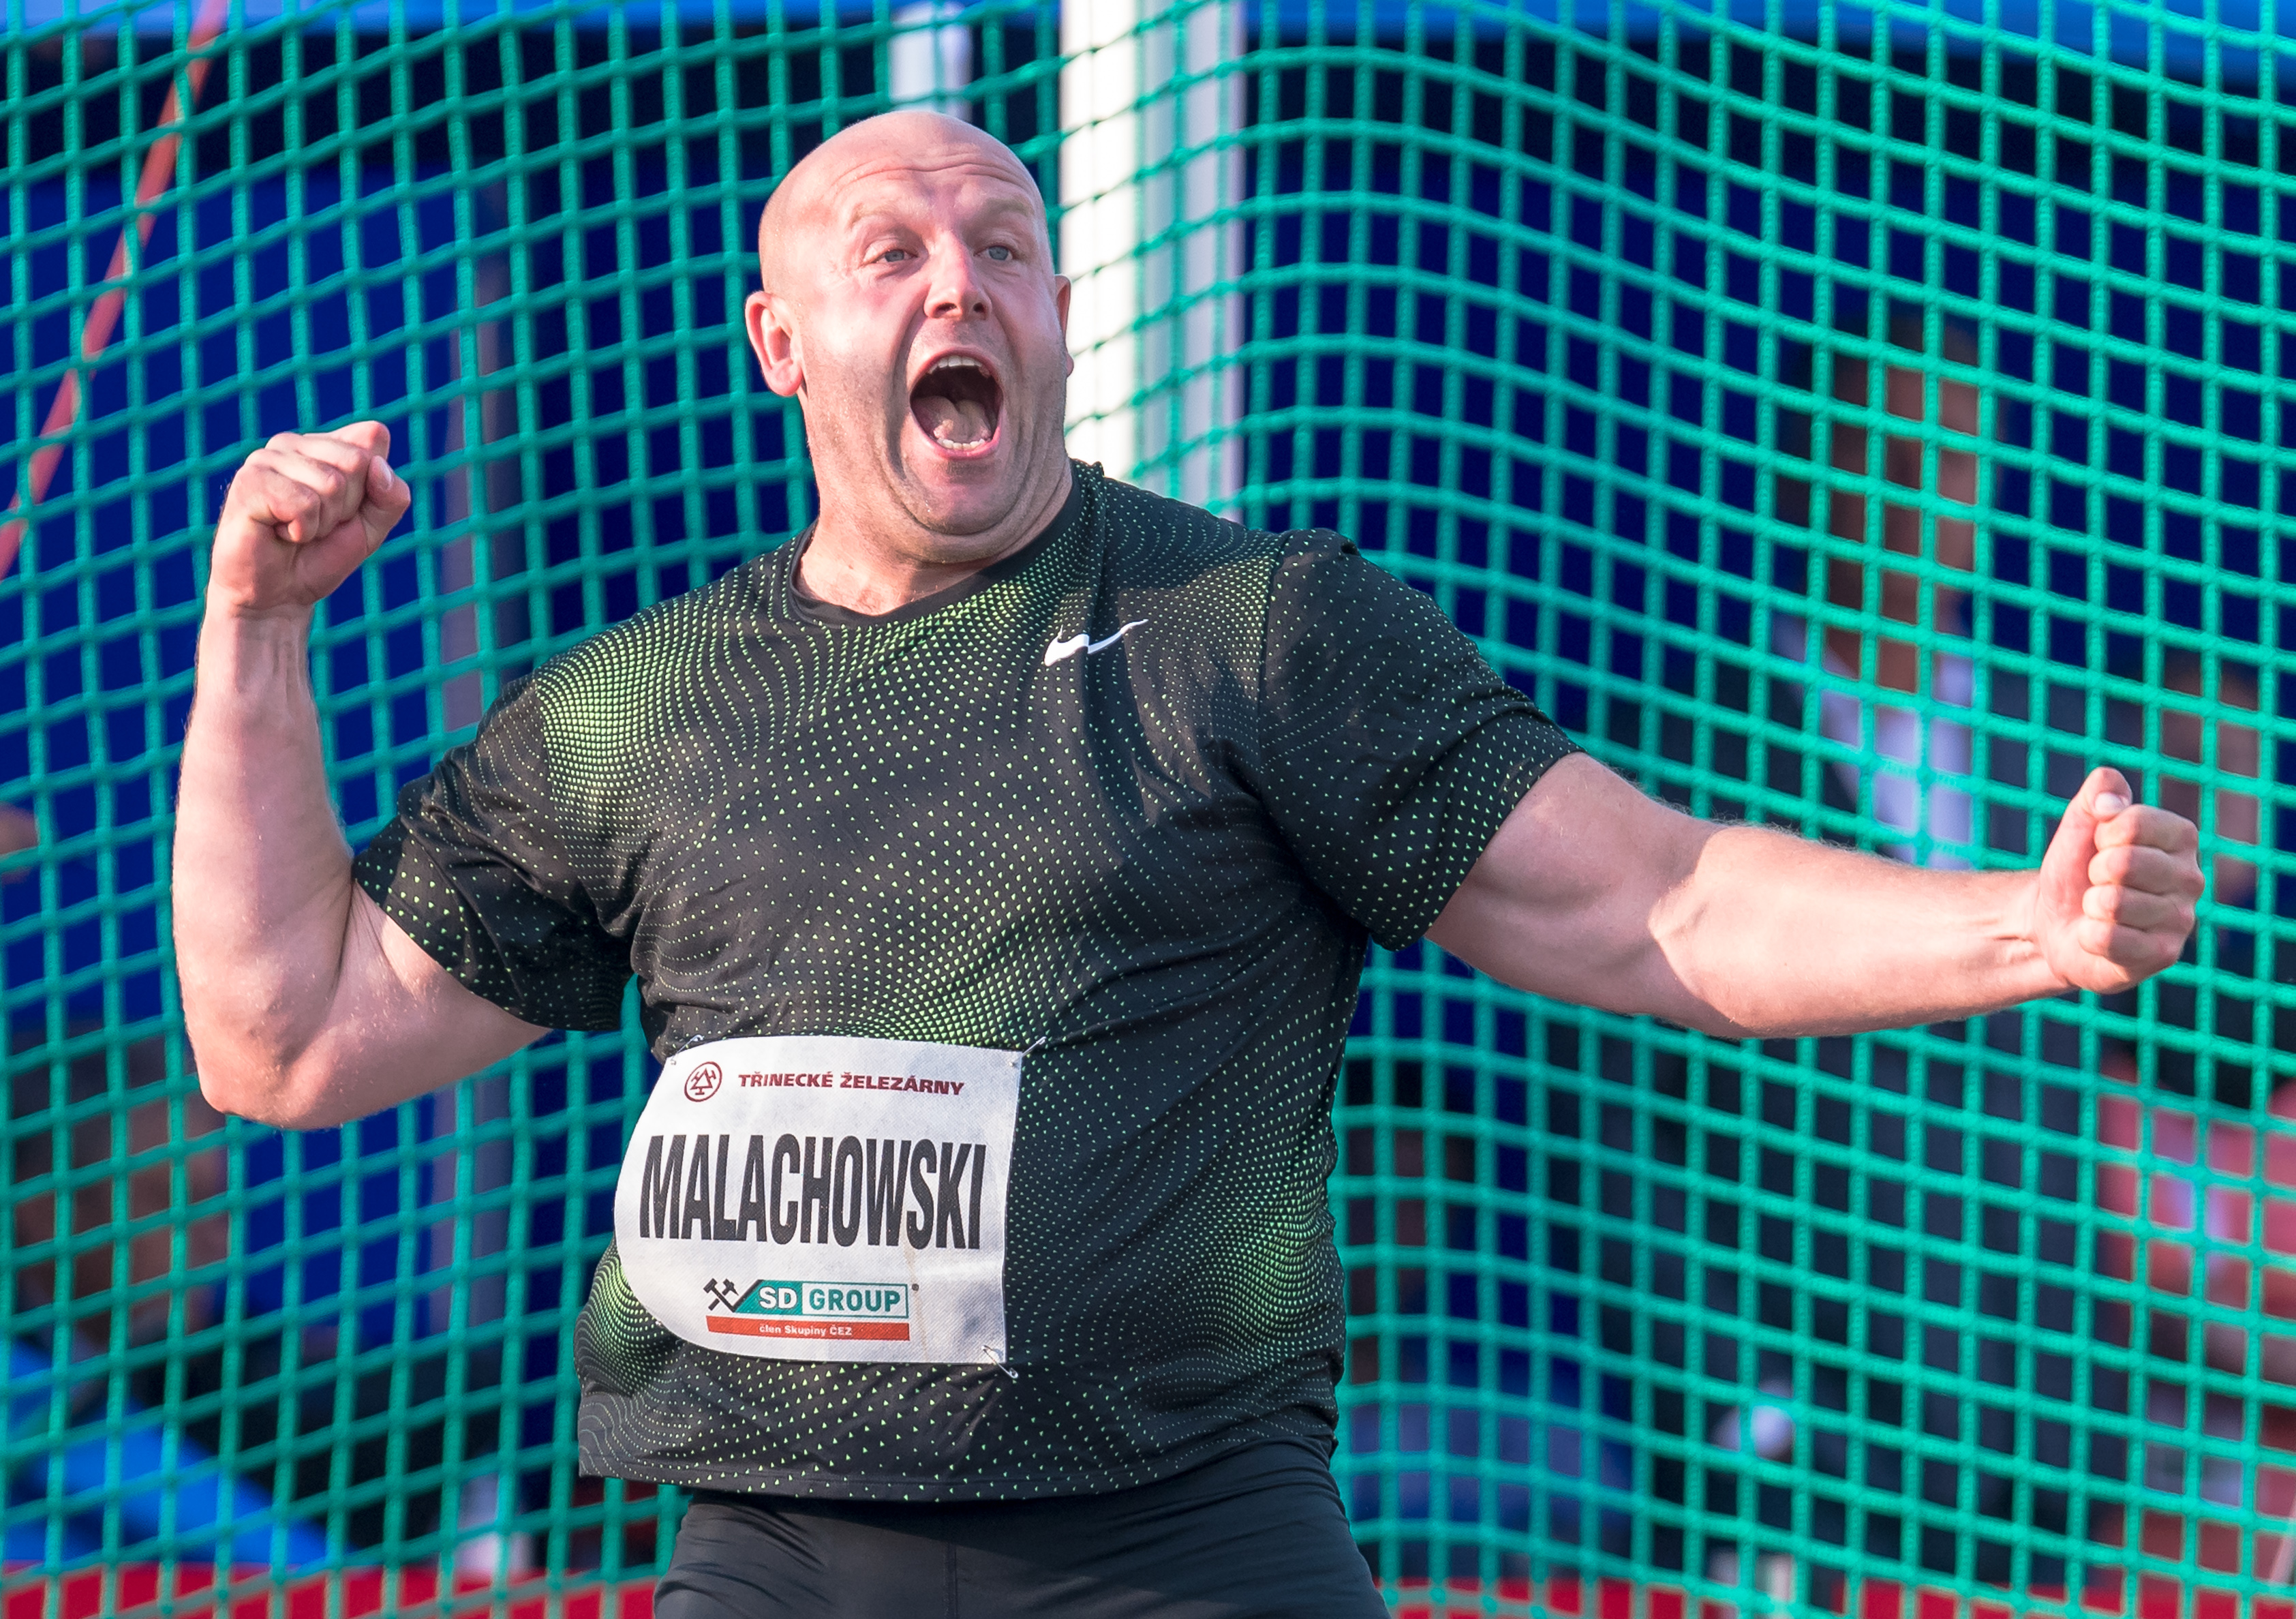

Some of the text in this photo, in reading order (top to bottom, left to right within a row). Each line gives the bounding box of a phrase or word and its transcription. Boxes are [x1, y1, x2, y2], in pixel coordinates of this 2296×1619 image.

[738, 1071, 965, 1095] TŘINECKÉ ŽELEZÁRNY
[639, 1134, 986, 1250] MALACHOWSKI
[759, 1286, 900, 1312] SD GROUP
[759, 1323, 853, 1336] člen Skupiny ČEZ
